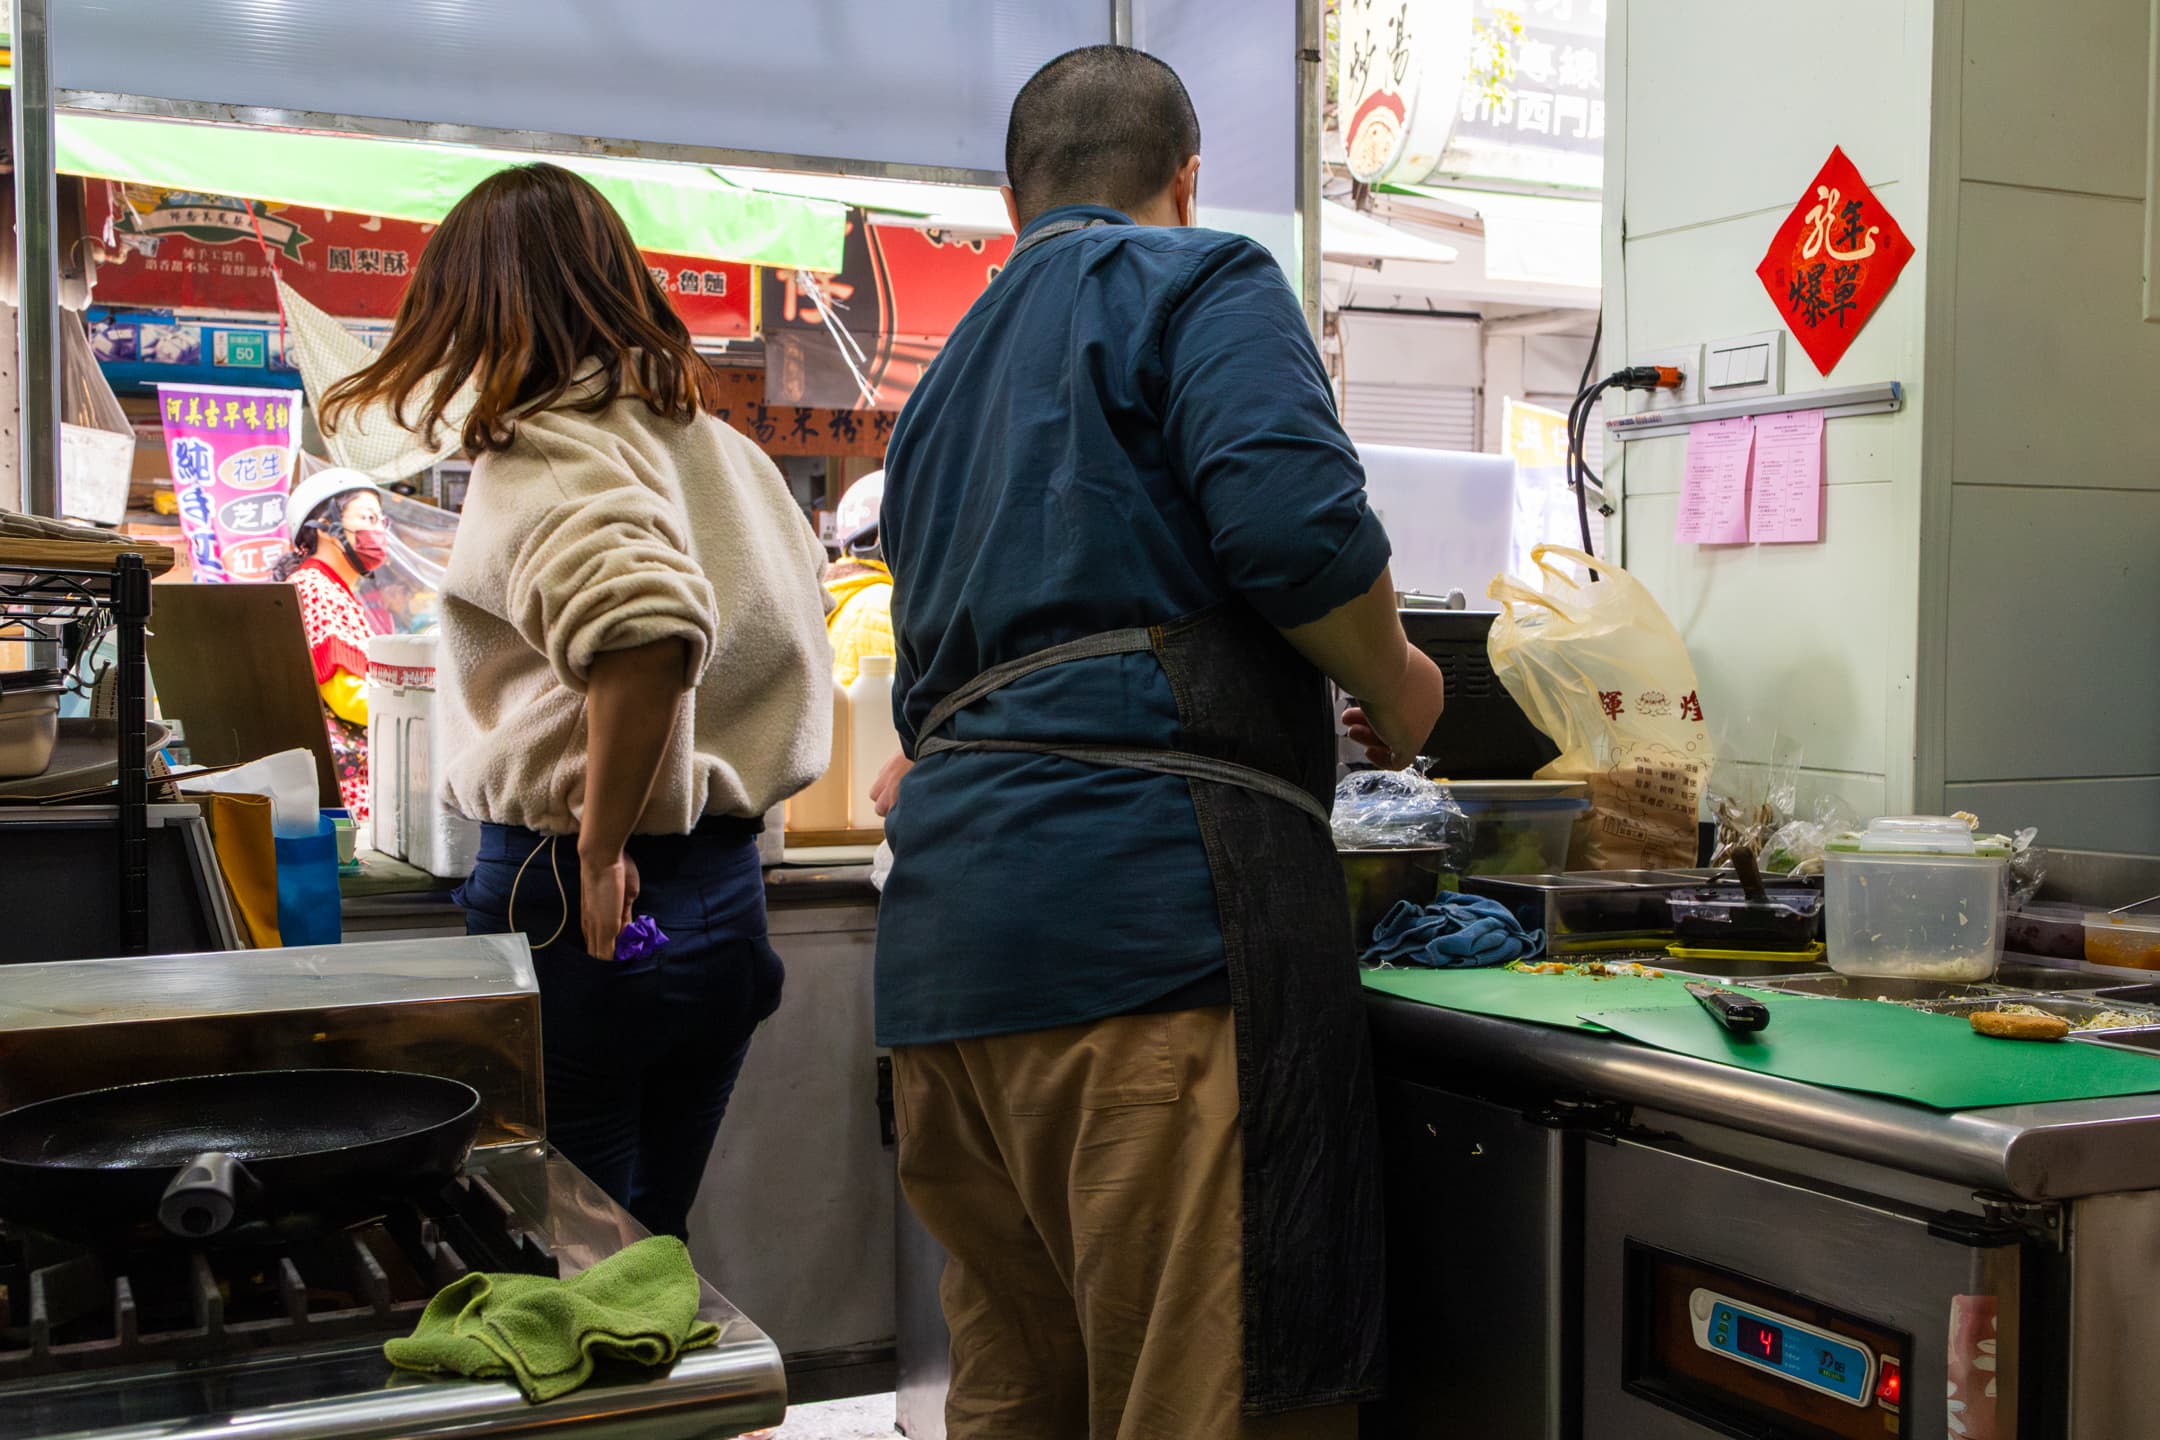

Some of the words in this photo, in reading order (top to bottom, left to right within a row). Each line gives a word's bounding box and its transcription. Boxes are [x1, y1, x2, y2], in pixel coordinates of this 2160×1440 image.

[328, 246, 408, 276] 鳳梨酥
[1789, 263, 1859, 328] 爆單
[236, 346, 254, 361] 50
[233, 453, 281, 483] 花生
[232, 497, 284, 529] 芝麻
[232, 544, 284, 574] 紅豆
[1759, 1329, 1774, 1356] 4
